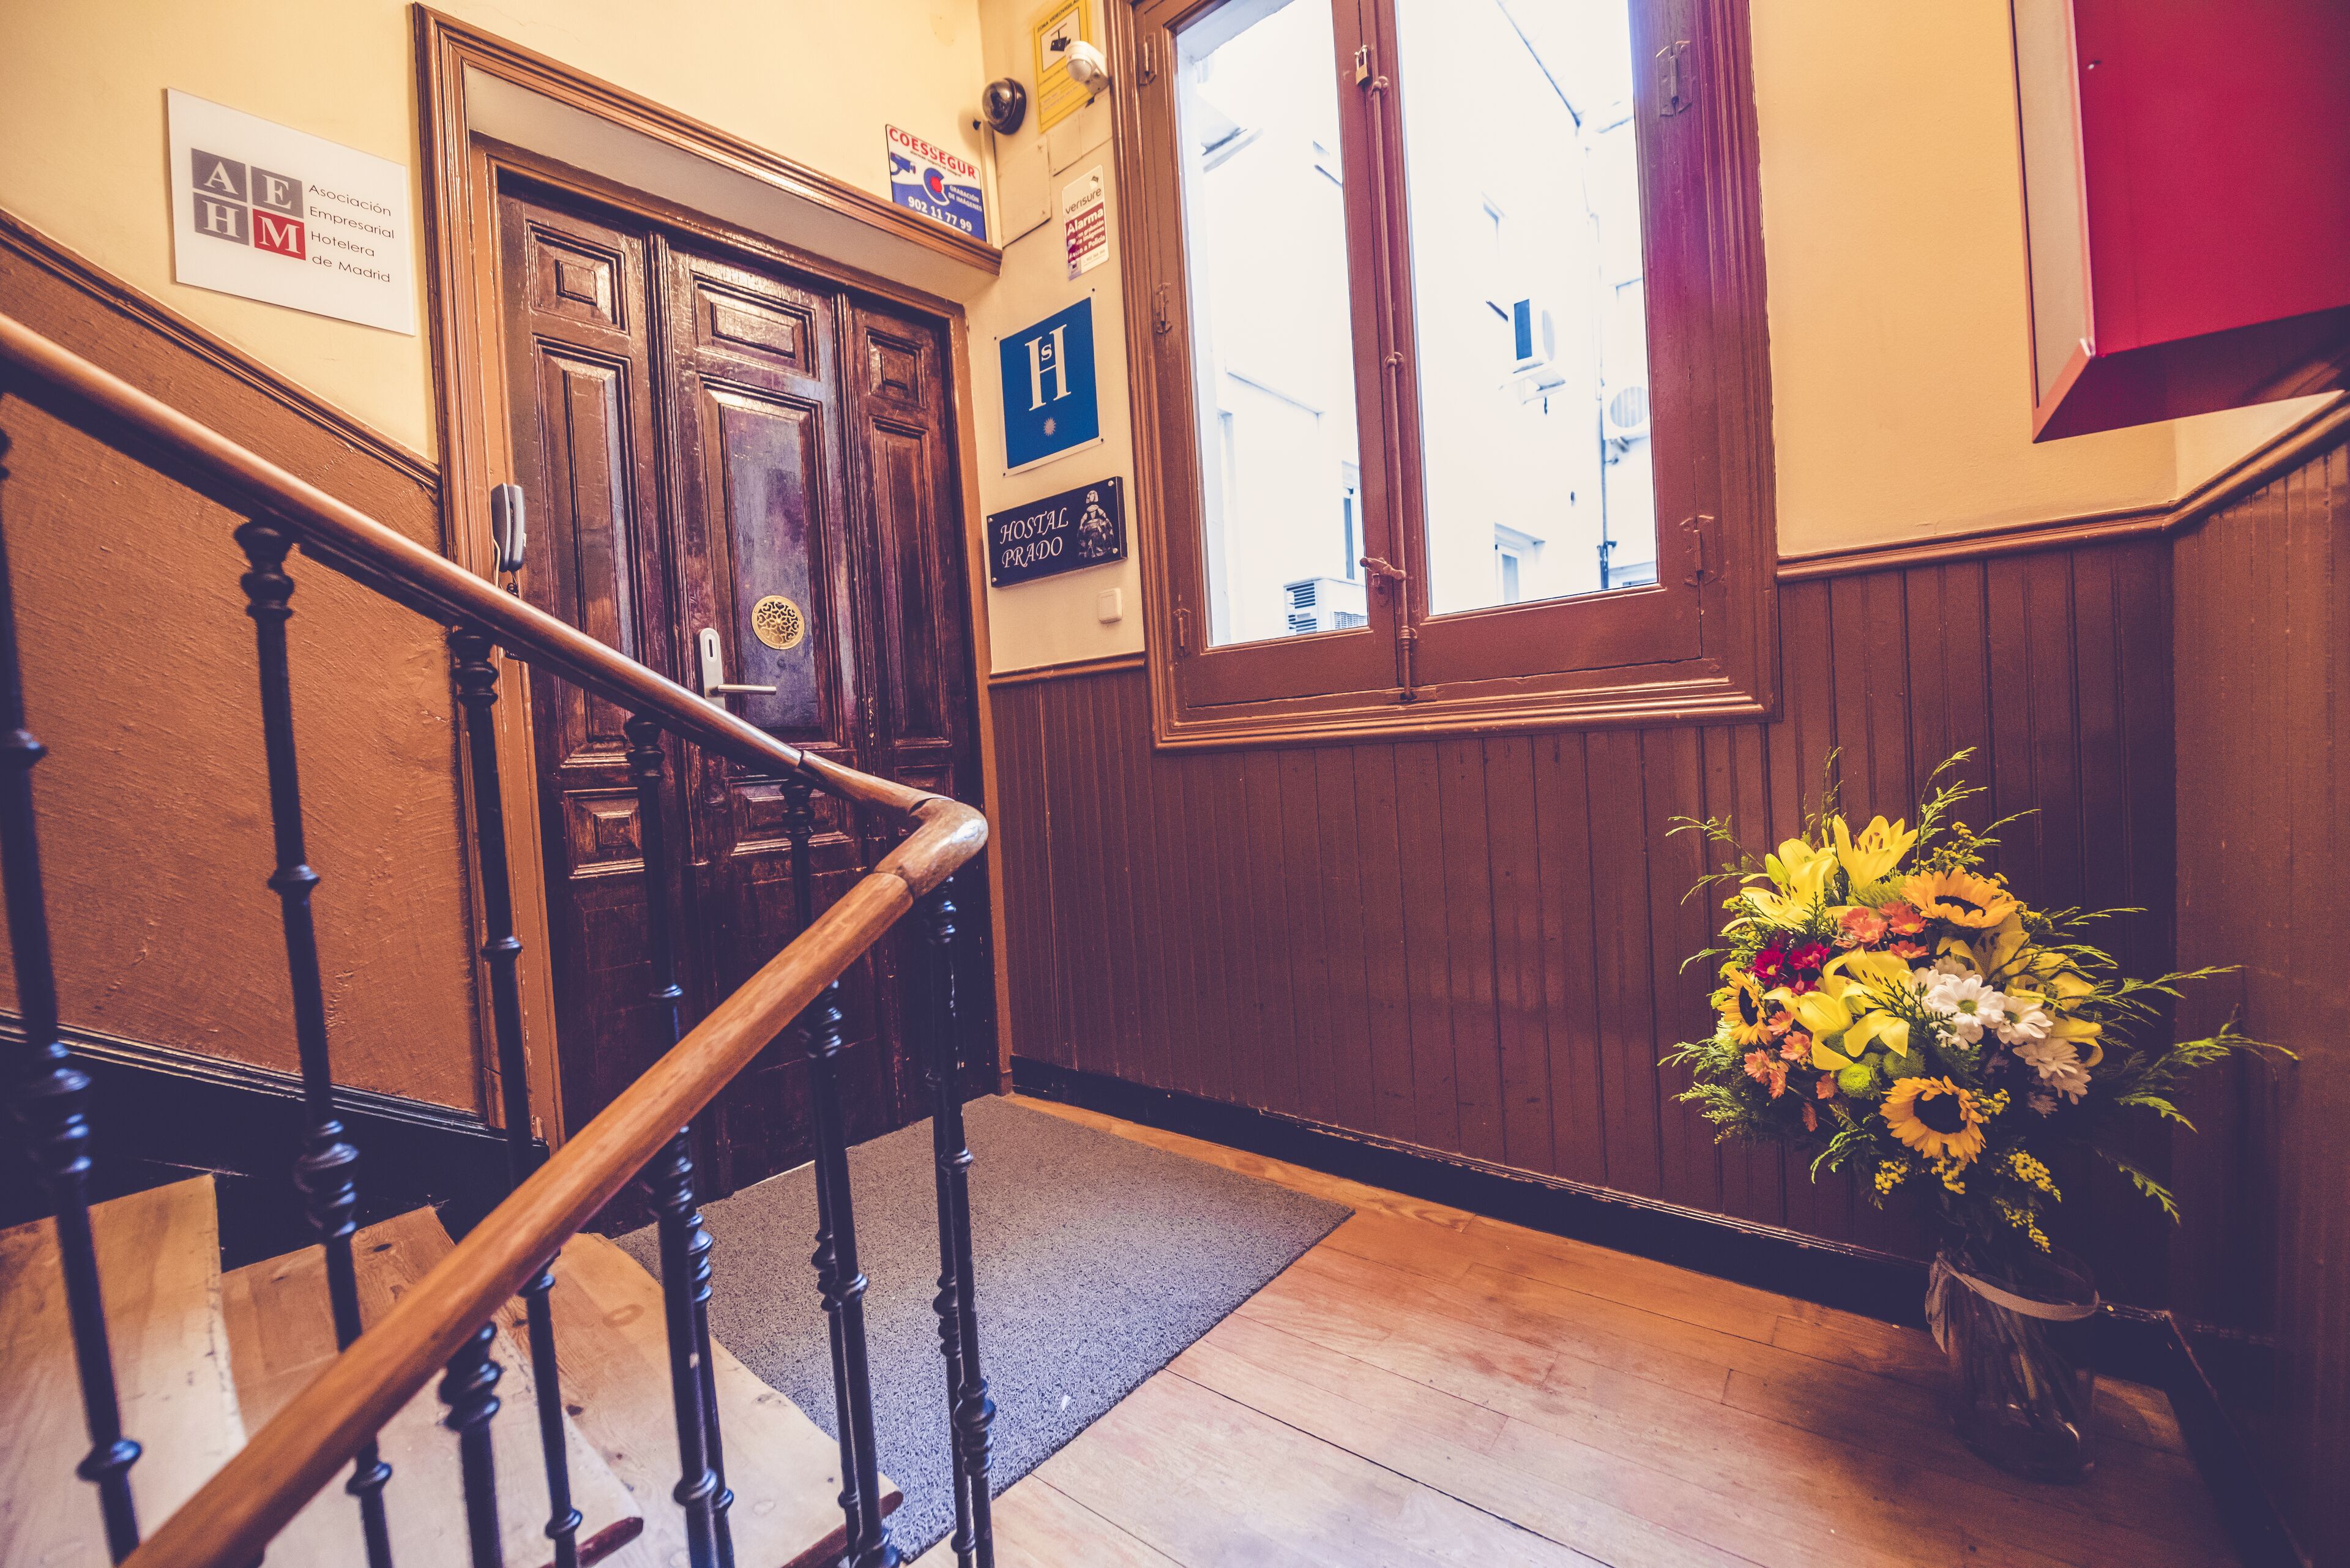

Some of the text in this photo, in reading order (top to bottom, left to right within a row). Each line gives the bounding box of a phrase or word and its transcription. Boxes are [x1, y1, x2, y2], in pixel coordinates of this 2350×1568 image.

[1049, 0, 1079, 23] VIDEOVIGILA
[889, 127, 976, 179] COESSEGUR
[309, 185, 391, 217] Asociación
[950, 185, 979, 203] GRABACIÓN
[956, 196, 982, 212] IMÁGENES
[1065, 188, 1102, 214] verisure
[310, 206, 395, 239] Empresarial
[908, 196, 972, 232] 902 11 77 99
[1067, 208, 1103, 236] Alarma
[1083, 226, 1104, 242] imágenes
[1084, 220, 1104, 236] grabación
[311, 231, 375, 257] Hotelera
[1069, 247, 1083, 259] Aviso
[1088, 235, 1105, 248] Policía
[312, 255, 390, 283] de Madrid
[1000, 507, 1068, 545] HOSTAL
[1002, 536, 1062, 568] PRADO
